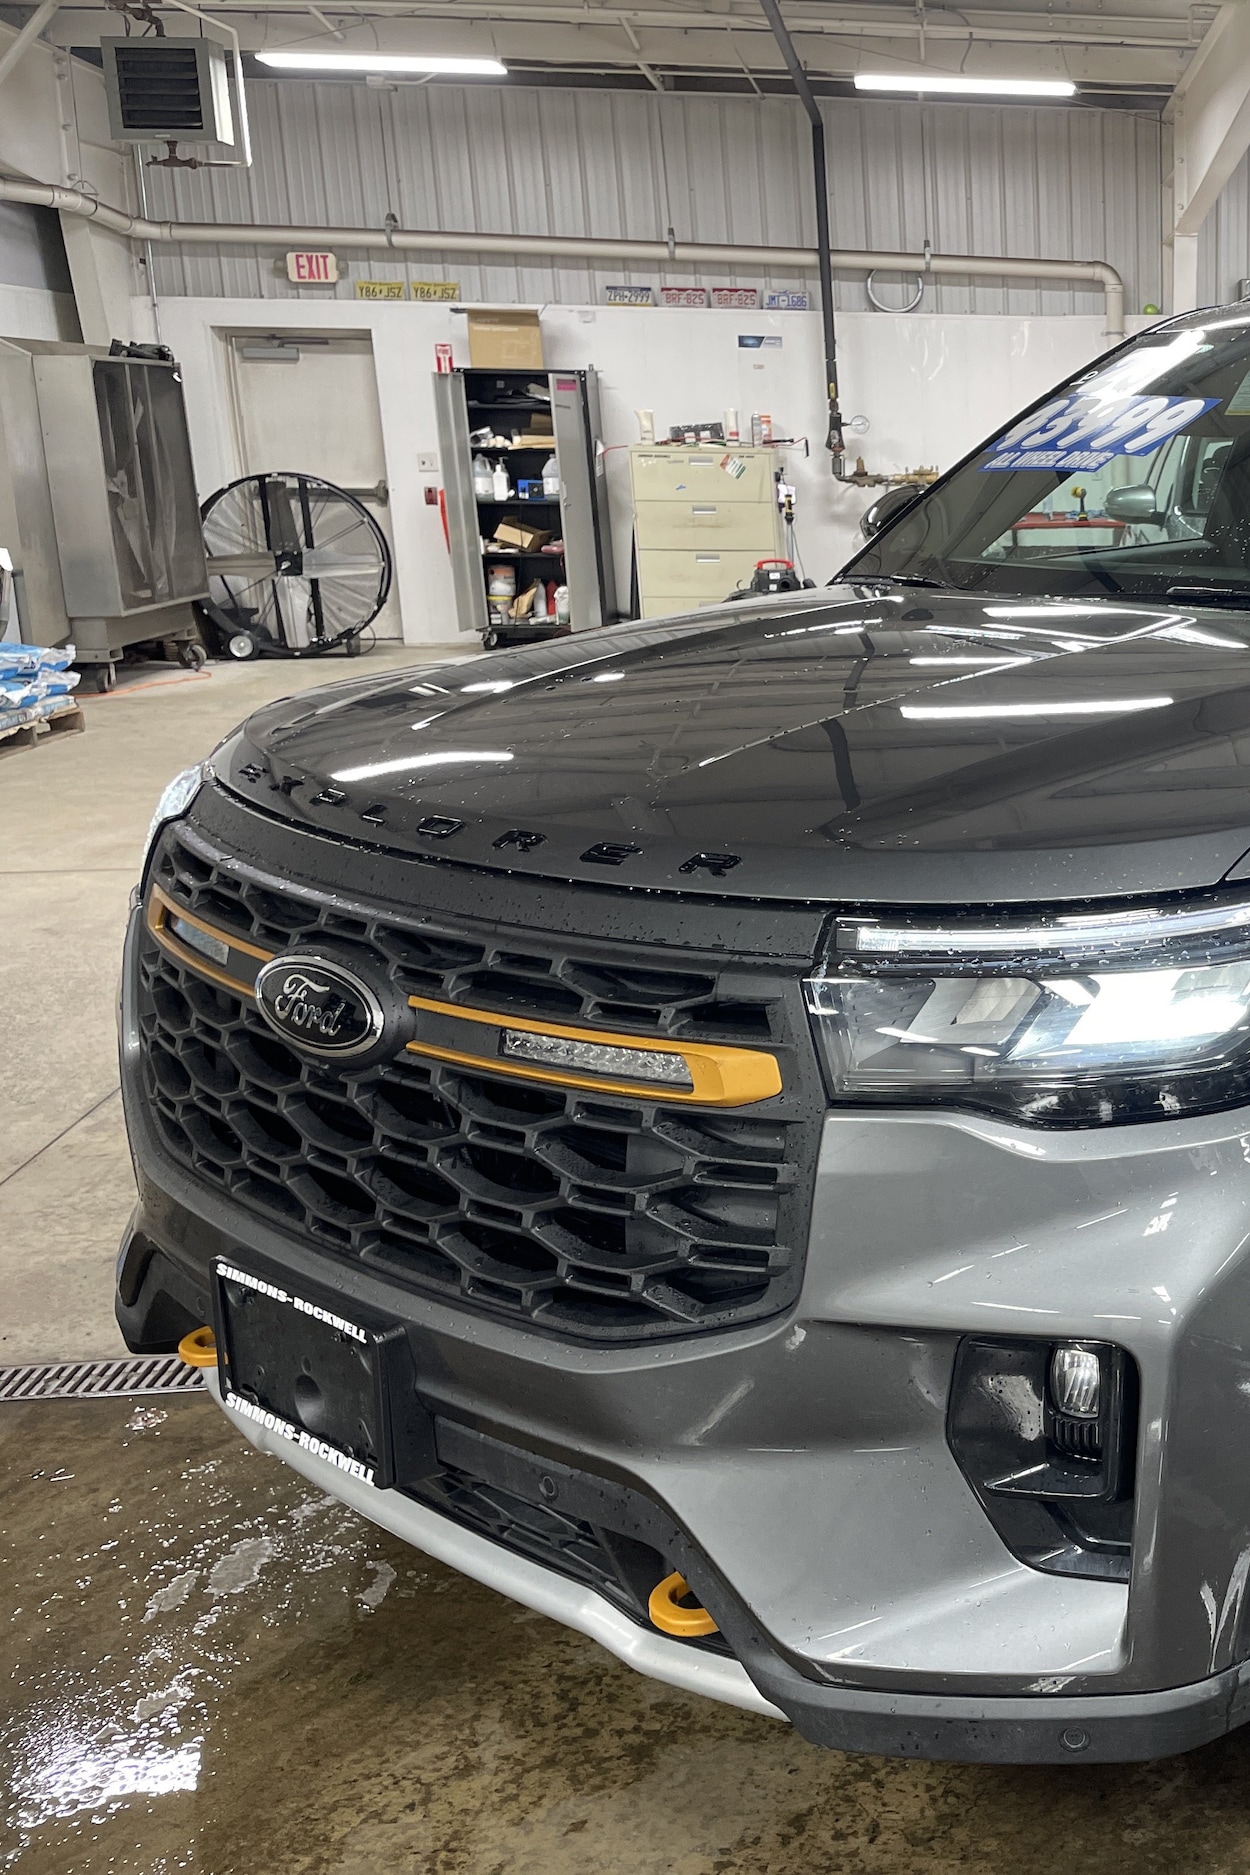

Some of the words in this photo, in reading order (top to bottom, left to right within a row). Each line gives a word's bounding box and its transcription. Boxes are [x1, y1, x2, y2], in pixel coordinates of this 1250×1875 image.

[295, 254, 329, 280] EXIT
[984, 452, 1021, 468] ALL
[1010, 451, 1068, 468] WHEEL
[1055, 451, 1115, 469] DRIVE
[238, 762, 742, 878] EXPLORER
[275, 973, 346, 1037] Ford
[215, 1262, 368, 1344] SIMMONS-ROCKWELL
[225, 1391, 376, 1487] SIMMONS-ROCKWELL
